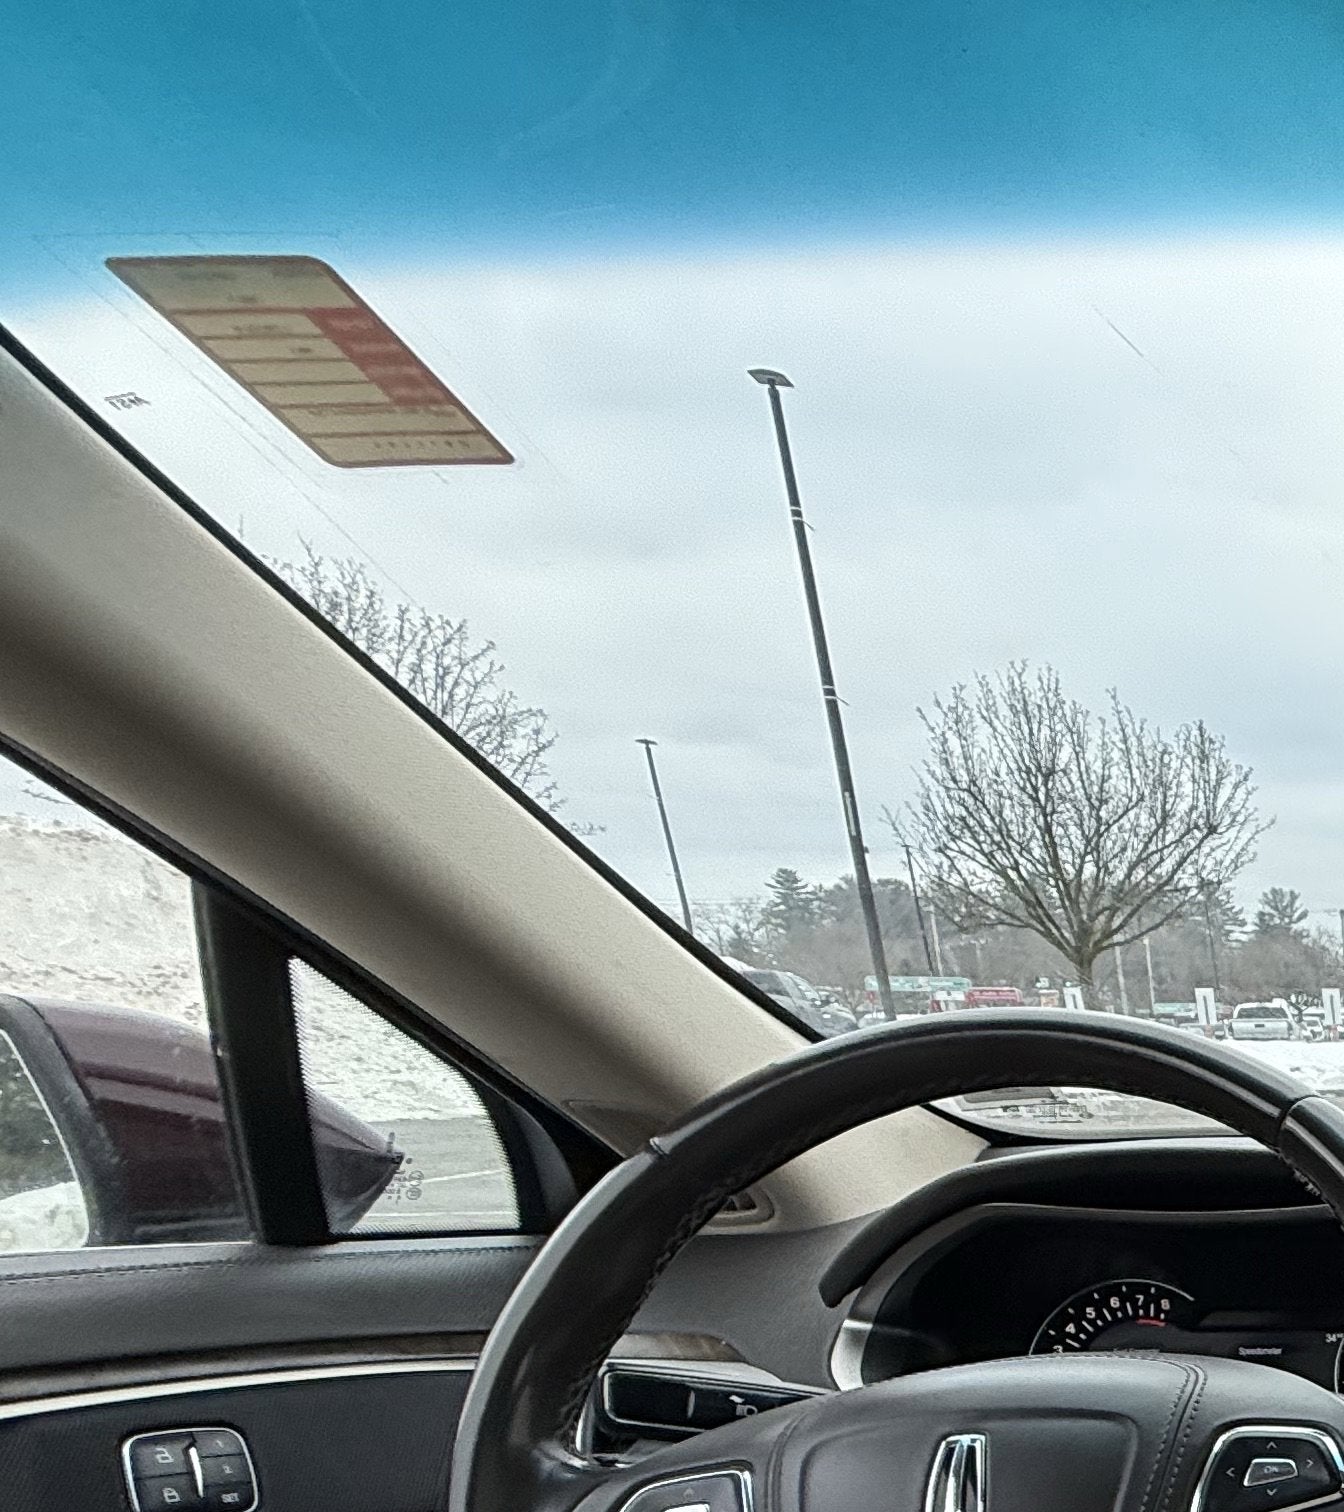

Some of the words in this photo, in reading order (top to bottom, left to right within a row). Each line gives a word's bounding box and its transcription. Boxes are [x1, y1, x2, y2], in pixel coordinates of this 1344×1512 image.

[1110, 1297, 1120, 1309] 6
[1136, 1295, 1145, 1306] 7
[1161, 1299, 1171, 1310] 8
[1086, 1307, 1096, 1319] 5
[1065, 1323, 1076, 1335] 4
